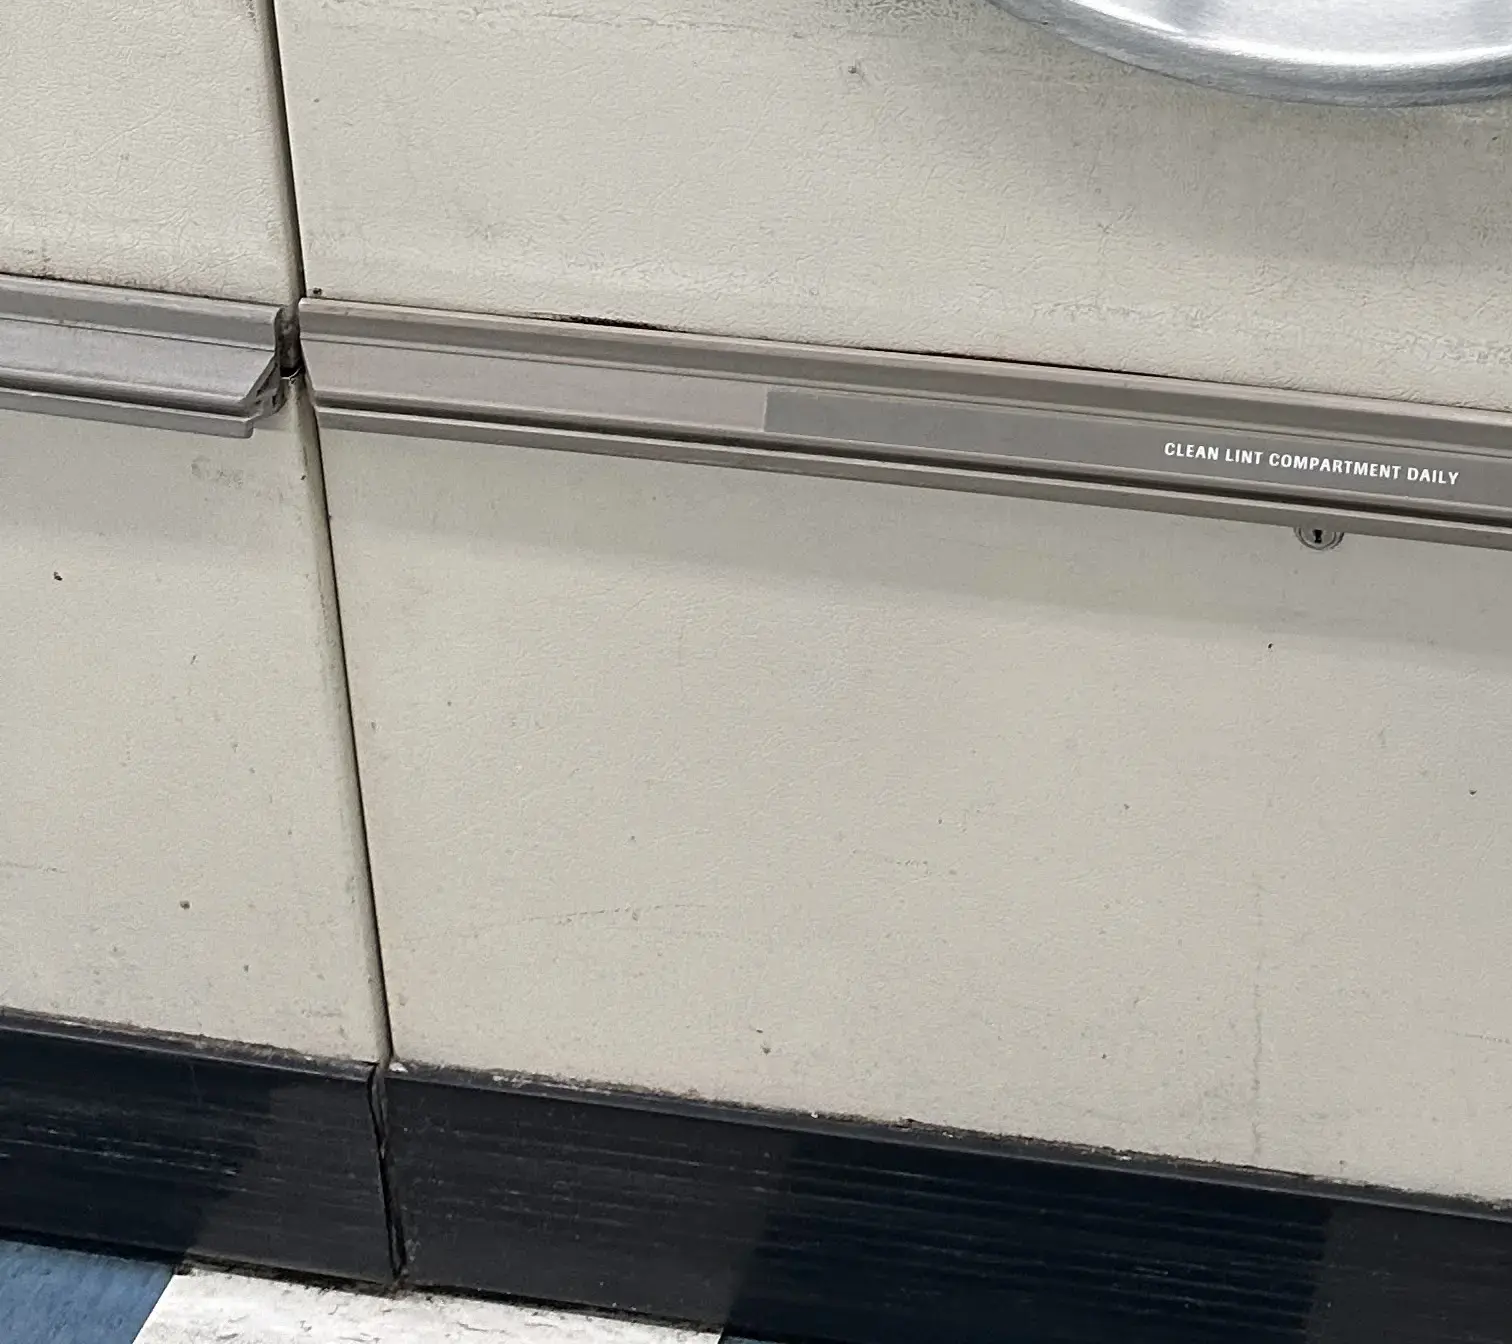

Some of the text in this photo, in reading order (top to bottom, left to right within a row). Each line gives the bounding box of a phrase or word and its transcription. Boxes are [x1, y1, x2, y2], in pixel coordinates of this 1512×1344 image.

[1164, 442, 1460, 486] CLEAN LINT COMPARTMENT DAILY
